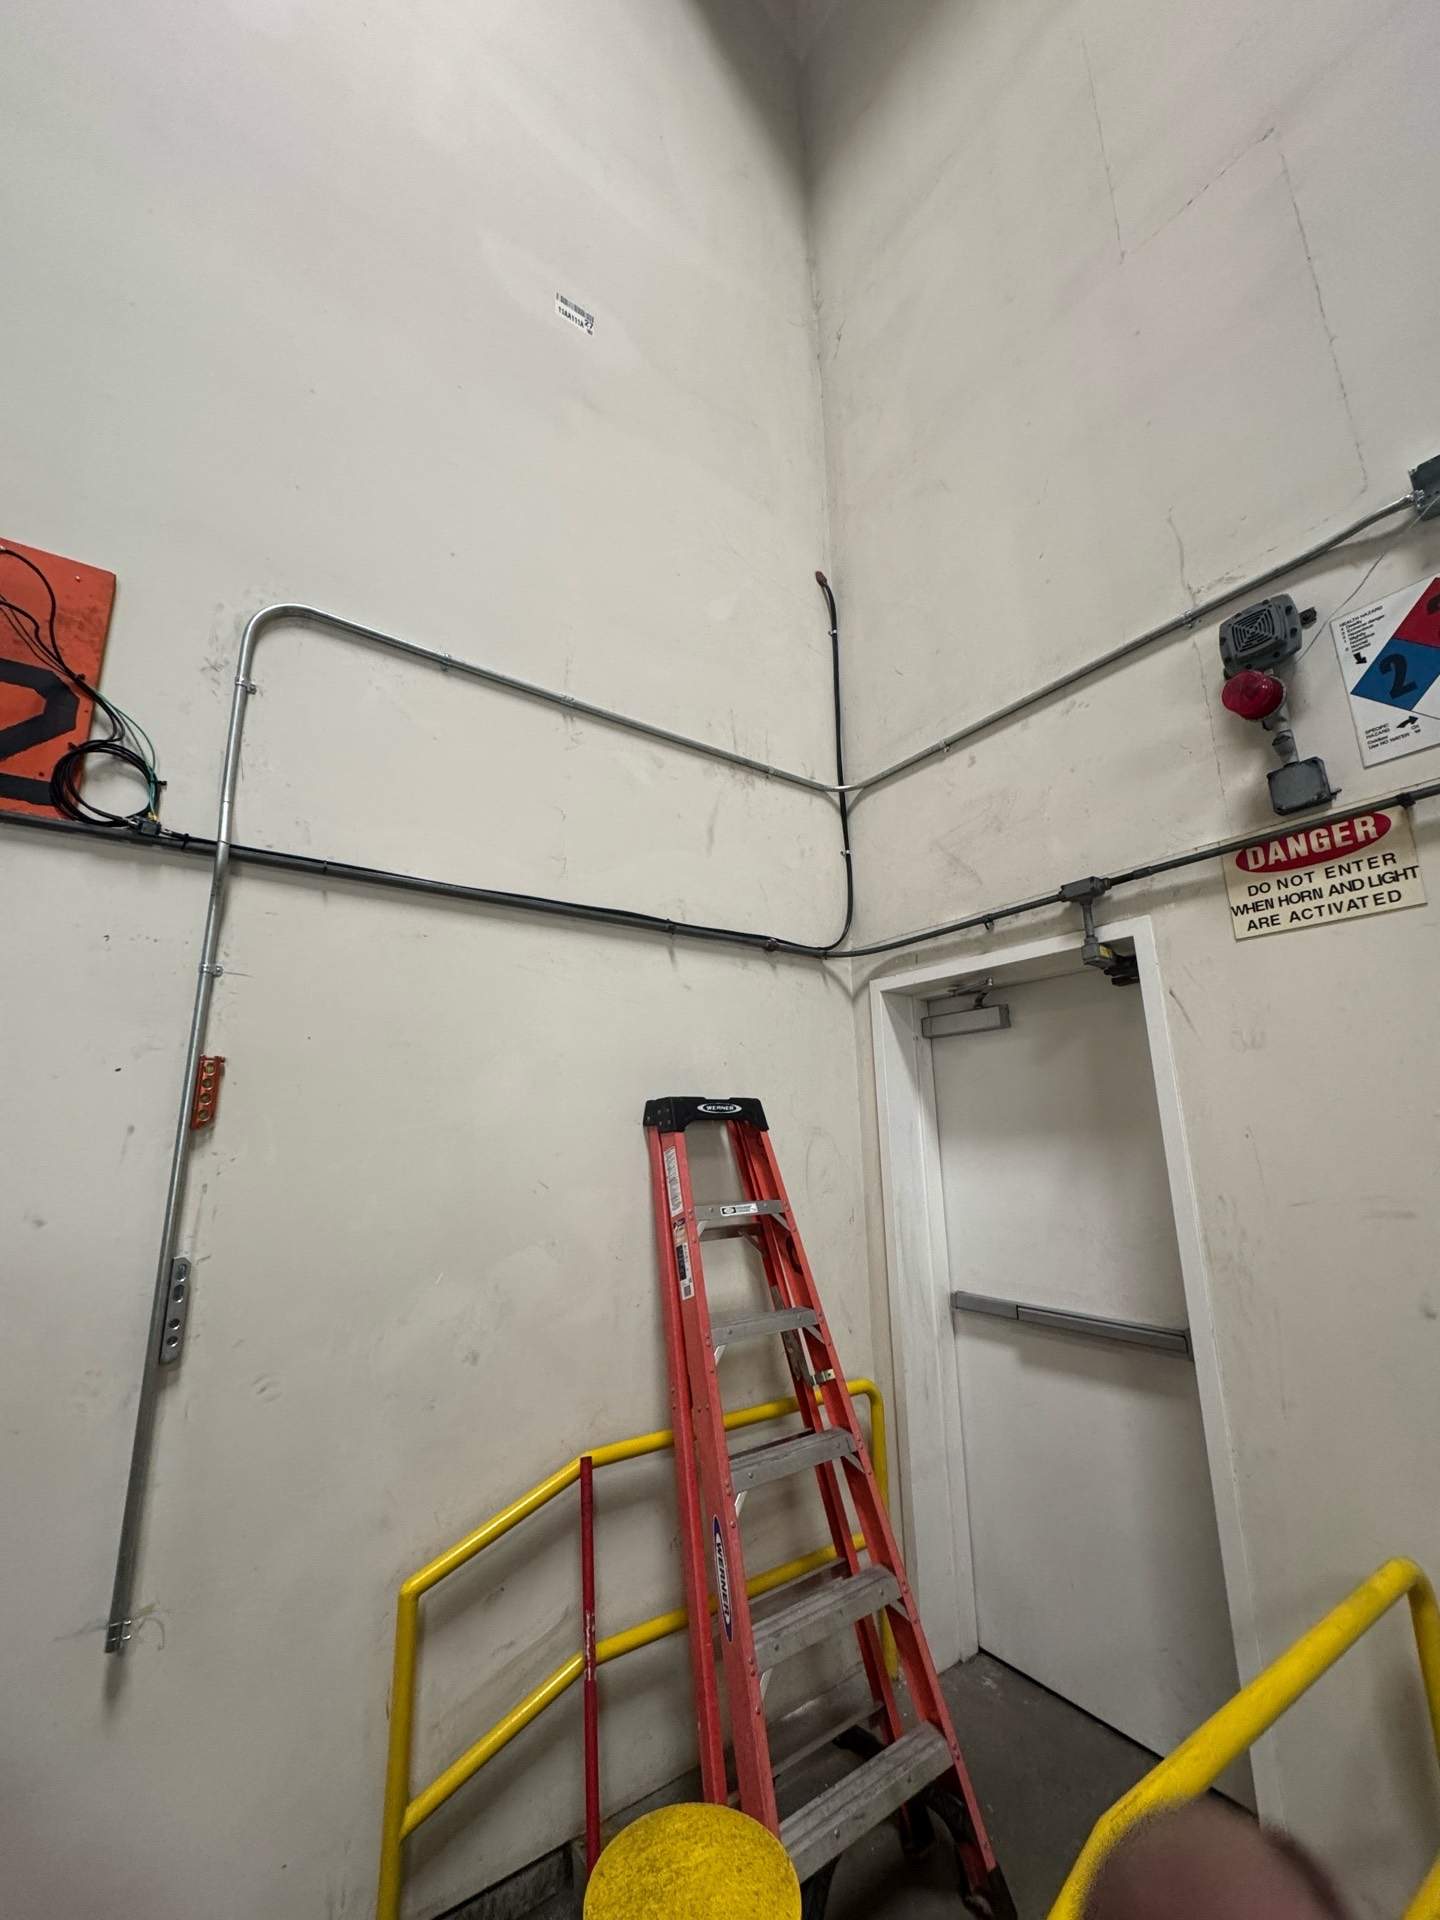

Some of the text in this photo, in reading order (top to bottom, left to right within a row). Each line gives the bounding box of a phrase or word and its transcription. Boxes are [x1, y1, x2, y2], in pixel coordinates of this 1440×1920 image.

[1379, 653, 1419, 700] 2
[1247, 815, 1379, 871] DANGER
[1230, 865, 1419, 917] WHEN HORN AND LIGHT
[1247, 852, 1397, 897] DO NOT ENTER
[1247, 889, 1402, 931] ARE ACTIVATED
[716, 1542, 731, 1617] WERNER
